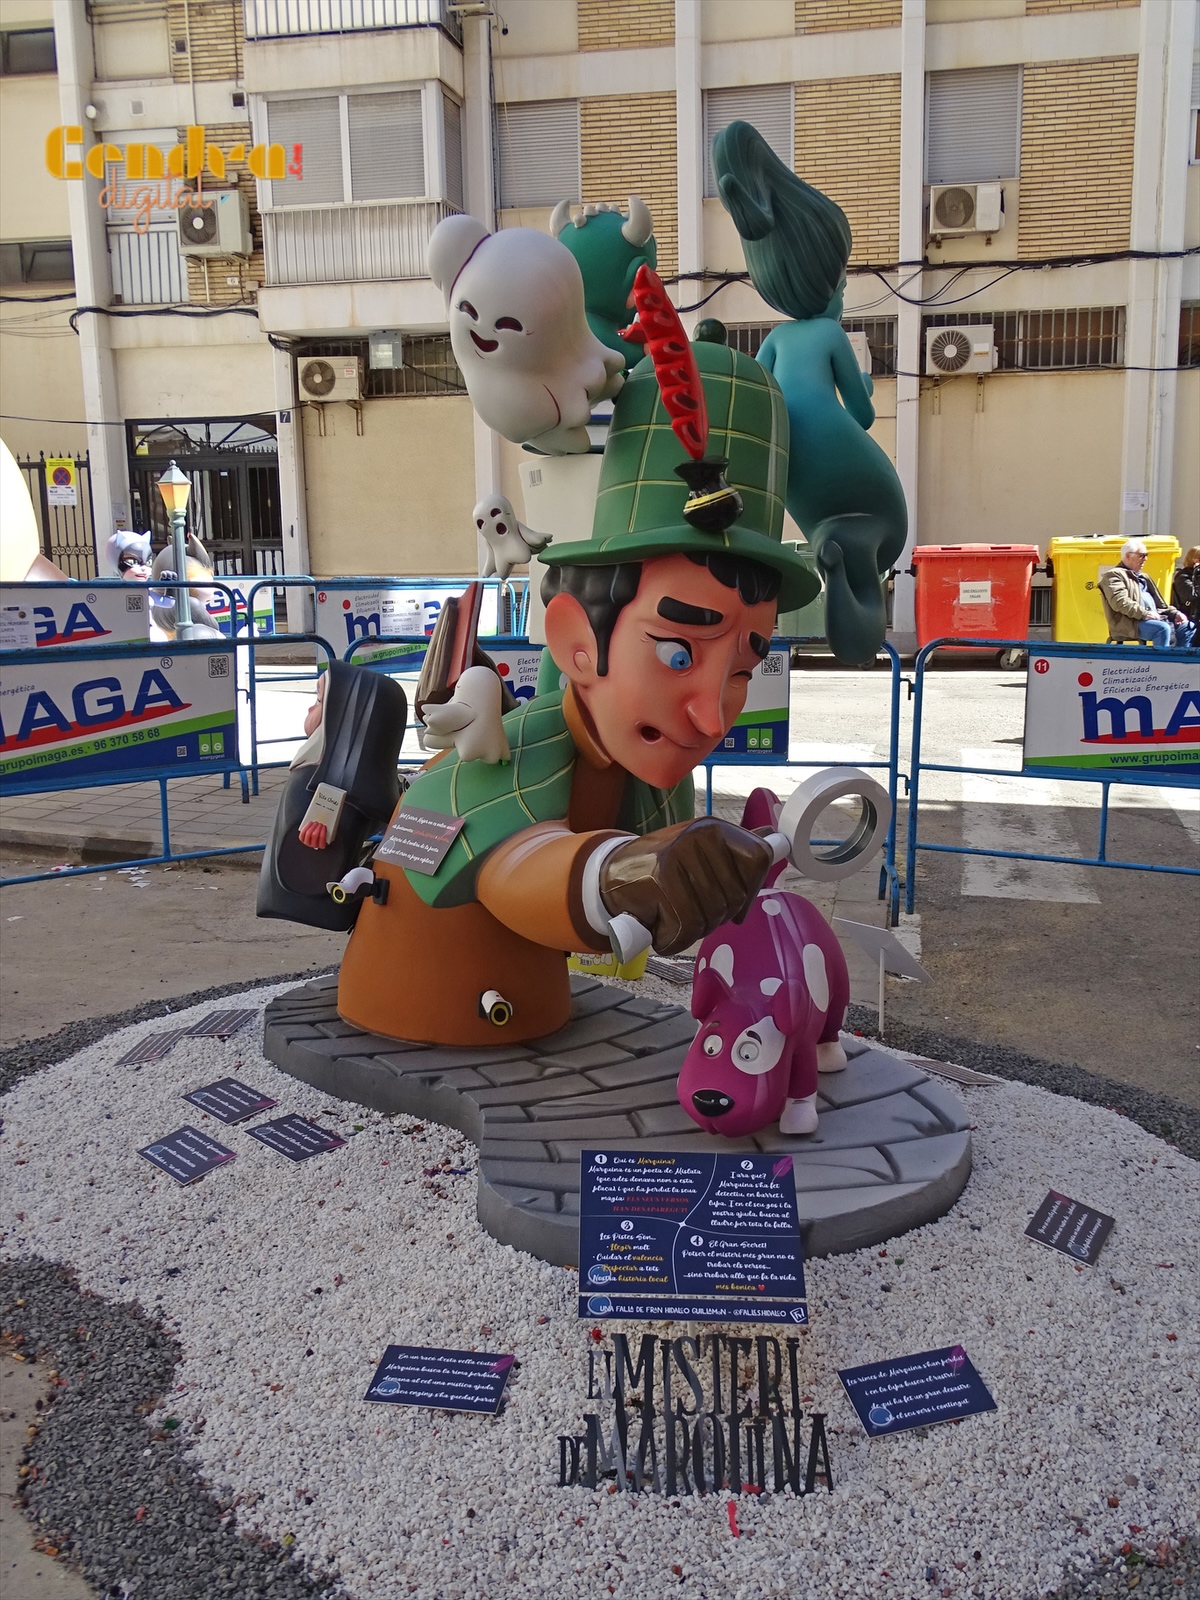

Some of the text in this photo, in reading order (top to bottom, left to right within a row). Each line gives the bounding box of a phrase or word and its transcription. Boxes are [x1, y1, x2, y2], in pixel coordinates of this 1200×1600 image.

[282, 411, 288, 422] 7
[1036, 661, 1048, 672] 11
[1102, 665, 1150, 676] Electricidad
[1102, 674, 1158, 685] Climatización
[1103, 682, 1190, 695] Eficiencia Energética
[94, 727, 160, 751] 96 370 58 68
[588, 1165, 623, 1174] Marquina
[642, 1167, 663, 1175] poeta
[674, 1167, 702, 1175] Mislata
[630, 1175, 656, 1183] donava
[718, 1180, 754, 1189] Marquina
[770, 1181, 780, 1190] fet
[645, 1186, 671, 1194] perdut
[756, 1191, 780, 1199] barret
[745, 1200, 753, 1208] el
[765, 1202, 778, 1210] gos
[710, 1219, 734, 1227] lladre
[734, 1220, 747, 1228] per
[764, 1220, 772, 1228] la
[612, 1232, 635, 1241] Pistes
[632, 1243, 651, 1251] molt
[708, 1240, 719, 1248] El
[719, 1240, 739, 1249] Gran
[596, 1253, 632, 1262] Cuidar el
[681, 1249, 706, 1258] Potser
[757, 1252, 776, 1261] gran
[601, 1264, 638, 1273] Respectar
[732, 1261, 743, 1269] els
[592, 1274, 669, 1283] Nostra local
[704, 1271, 729, 1279] trobar
[746, 1274, 760, 1282] que
[760, 1272, 769, 1281] fa
[779, 1273, 797, 1281] vida
[730, 1282, 757, 1290] bonica
[599, 1305, 614, 1313] UNA
[645, 1306, 663, 1314] FRAN
[385, 1363, 420, 1372] Marquina
[420, 1366, 441, 1374] busca
[857, 1374, 877, 1383] rimes
[889, 1365, 922, 1377] Marquina
[940, 1355, 965, 1366] perdut
[887, 1383, 904, 1391] lupa
[904, 1379, 925, 1387] busca
[473, 1395, 497, 1403] parat
[893, 1397, 903, 1405] ha
[903, 1395, 914, 1403] fet
[924, 1389, 942, 1400] gran
[916, 1407, 931, 1415] vers
